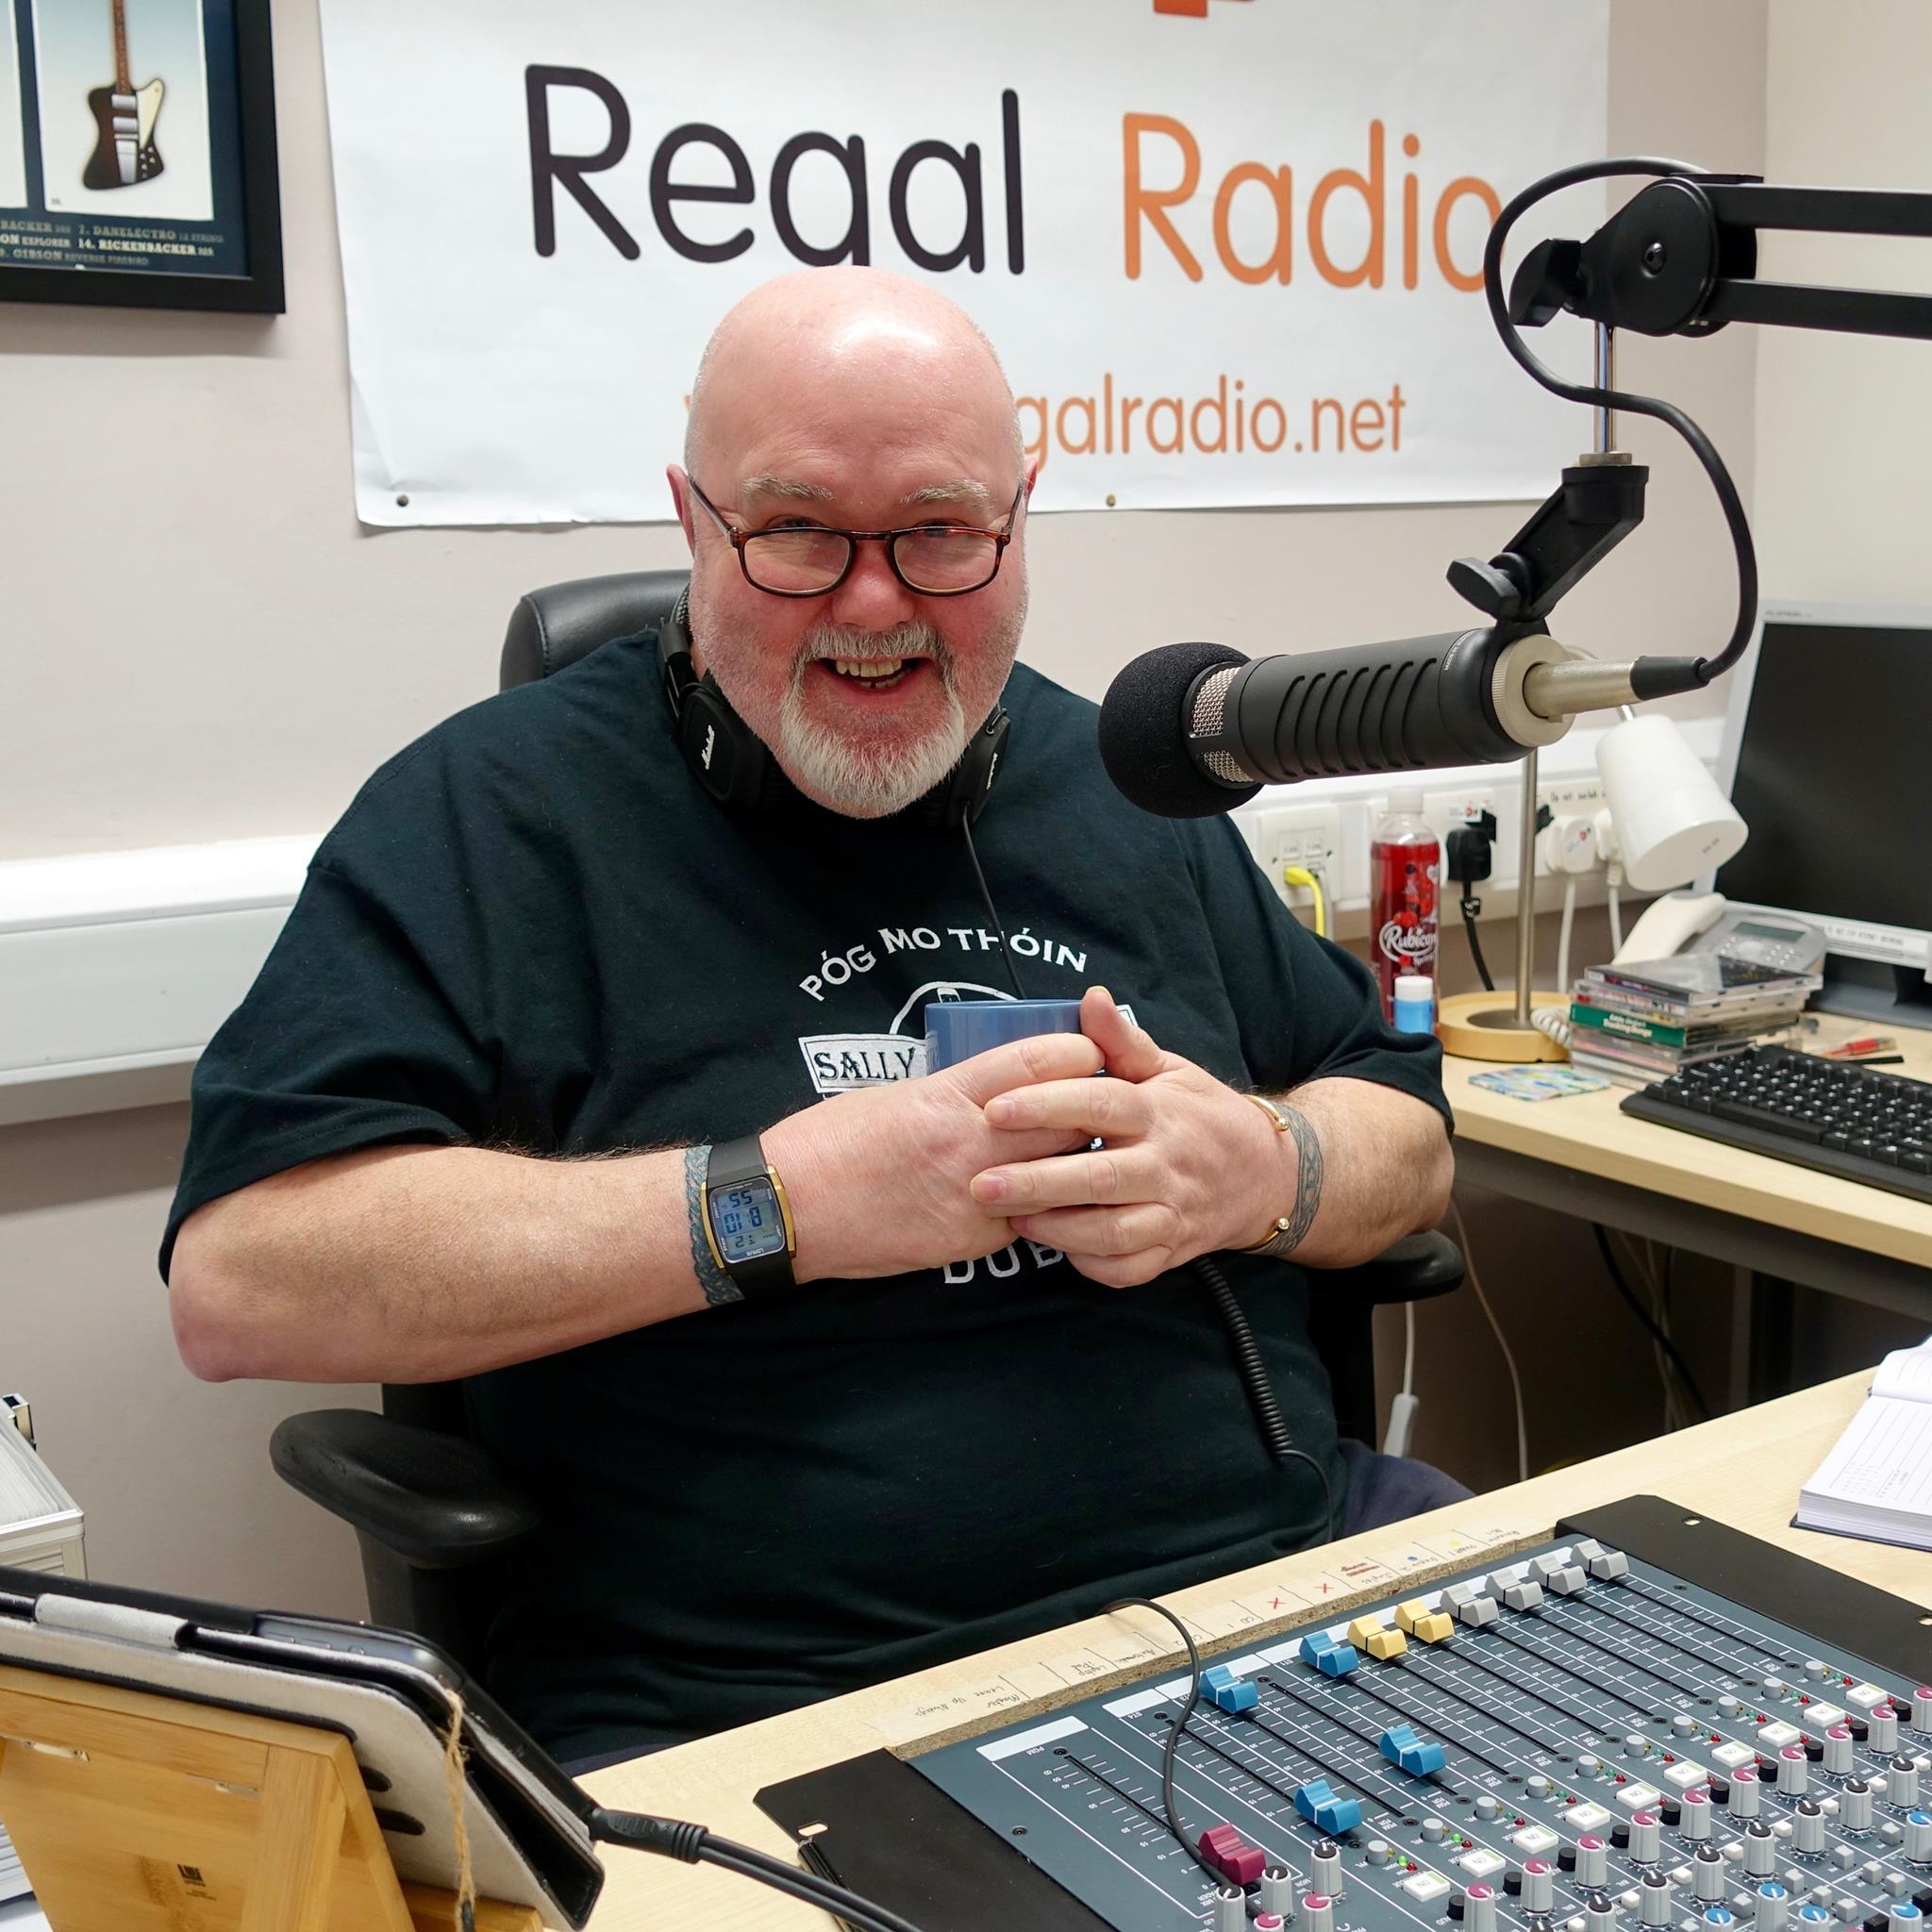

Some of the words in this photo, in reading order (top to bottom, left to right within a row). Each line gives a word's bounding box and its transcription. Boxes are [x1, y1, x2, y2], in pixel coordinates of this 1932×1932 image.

[1123, 111, 1507, 292] Radio
[93, 225, 175, 241] DANELECTRO
[13, 249, 63, 261] GIBSON
[98, 240, 196, 256] RICKENBACKER
[1384, 926, 1438, 950] Rubicon
[799, 944, 876, 1001] PÓG
[877, 927, 941, 955] MO
[947, 927, 1087, 973] THÓIN
[813, 1046, 916, 1082] SALLY
[1025, 1745, 1045, 1756] PGM
